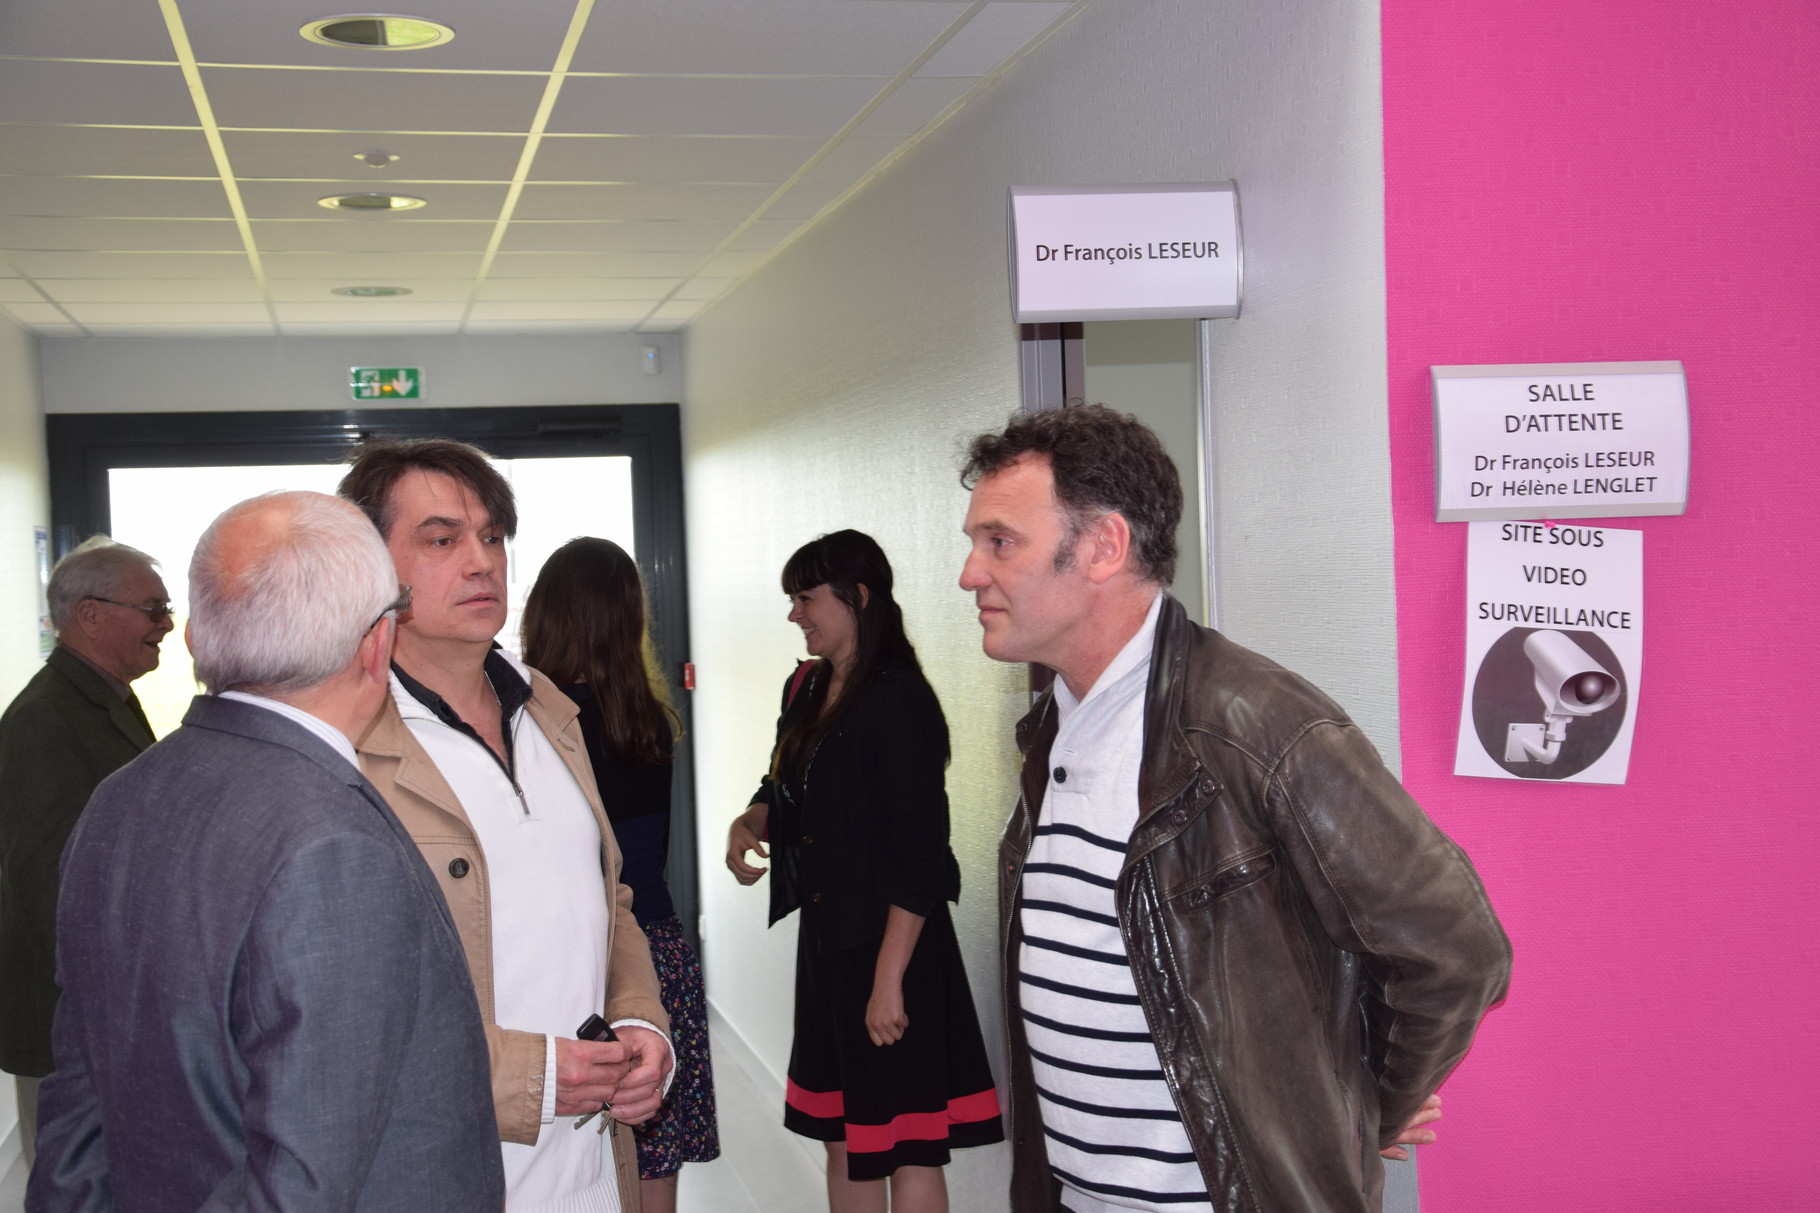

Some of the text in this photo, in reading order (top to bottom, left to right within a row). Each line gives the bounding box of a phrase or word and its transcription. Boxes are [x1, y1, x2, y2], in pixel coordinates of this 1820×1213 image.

[1036, 241, 1220, 265] Dr François LESEUR
[1528, 383, 1596, 402] SALLE
[1505, 412, 1624, 433] D'ATTENTE
[1474, 451, 1655, 473] Dr François LESEUR
[1470, 476, 1658, 497] Dr Hélène LENGLET
[1502, 523, 1604, 548] SITE SOUS
[1523, 564, 1587, 586] VIDEO
[1478, 601, 1632, 630] SURVEILLANCE
